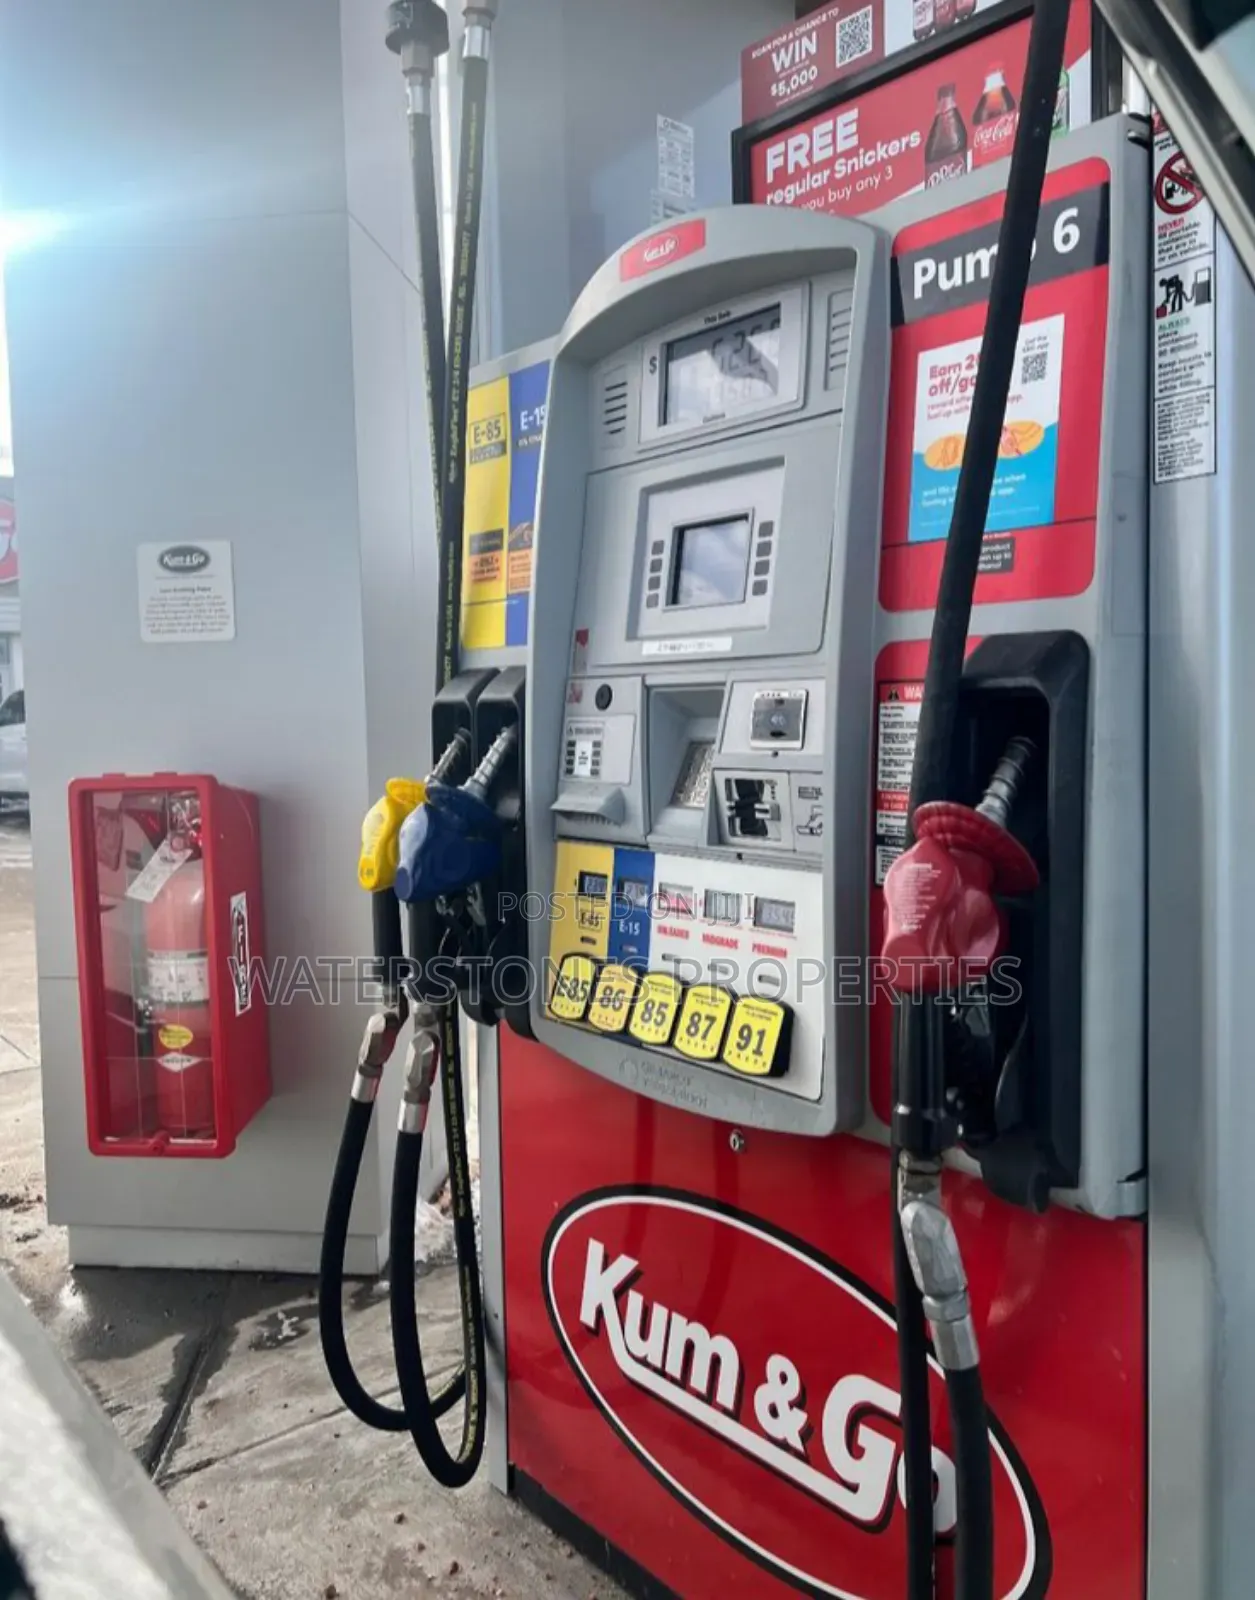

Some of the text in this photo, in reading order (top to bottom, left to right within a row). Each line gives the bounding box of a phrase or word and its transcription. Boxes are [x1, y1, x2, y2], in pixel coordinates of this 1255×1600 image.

[827, 7, 839, 21] TO
[771, 32, 818, 73] WIN
[770, 65, 818, 97] $5,000
[766, 108, 859, 183] FREE
[766, 168, 831, 206] regular
[834, 130, 922, 178] Snickers
[828, 184, 851, 203] buy
[856, 173, 881, 193] any
[884, 164, 893, 181] 3
[913, 207, 1080, 300] Pum 6
[649, 355, 658, 375] $
[929, 361, 962, 380] Earn
[473, 419, 501, 445] E-85
[619, 919, 641, 937] E-15
[752, 942, 787, 958] PREMIUM
[556, 974, 590, 1002] E85
[600, 985, 626, 1012] 86
[640, 998, 669, 1027] 85
[686, 1011, 717, 1041] 87
[736, 1023, 767, 1056] 91
[579, 1237, 959, 1534] Kum & Go
